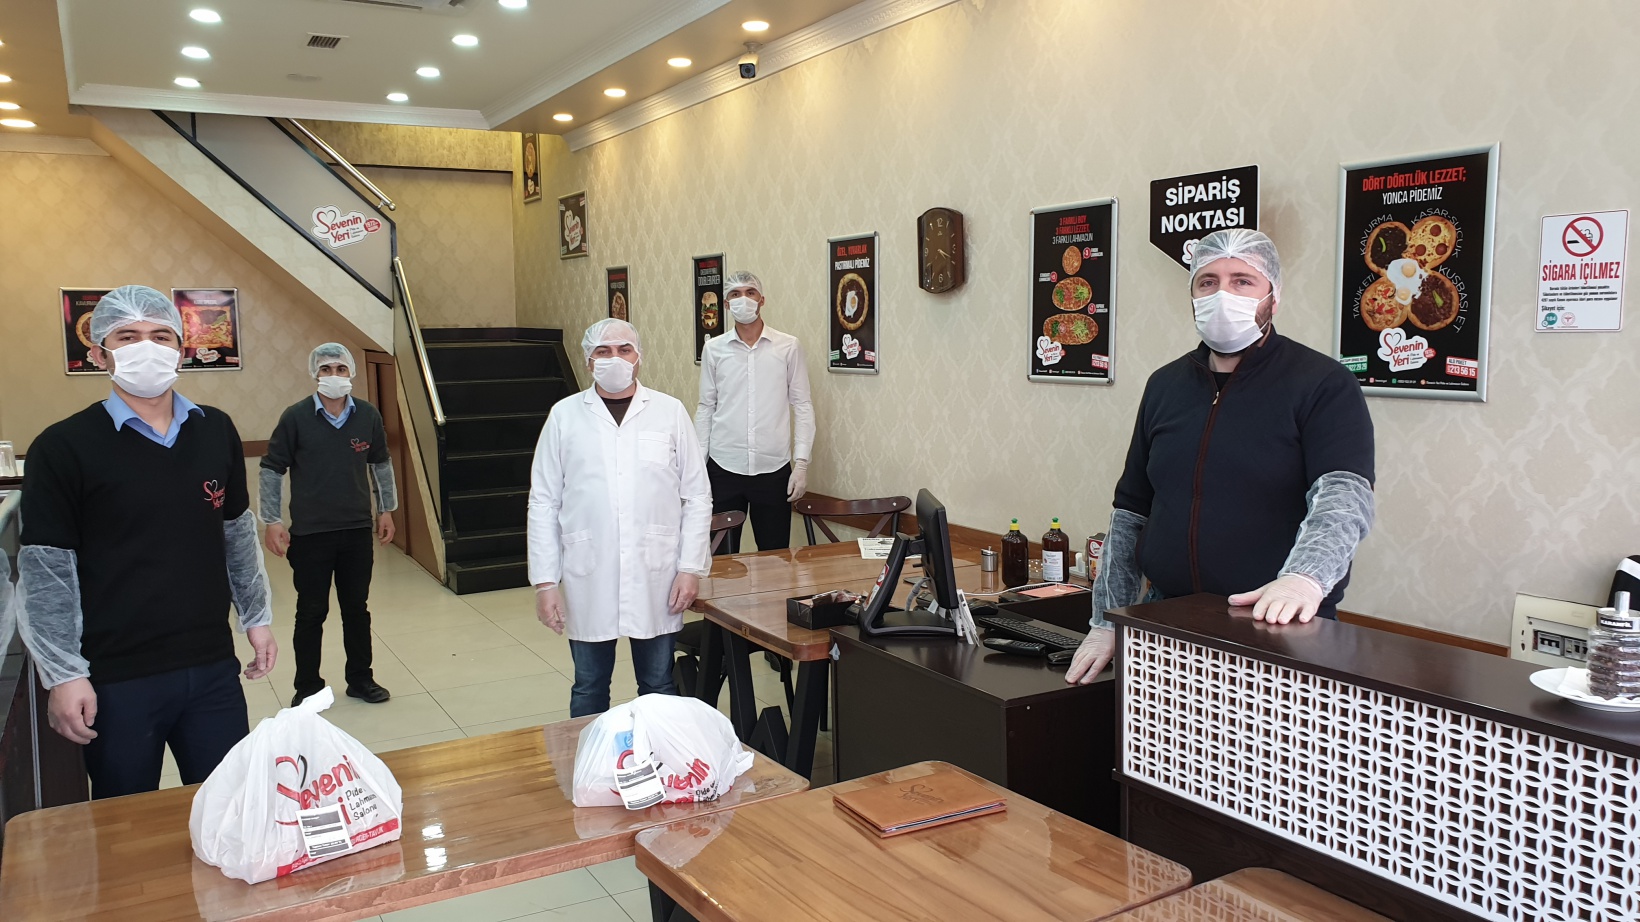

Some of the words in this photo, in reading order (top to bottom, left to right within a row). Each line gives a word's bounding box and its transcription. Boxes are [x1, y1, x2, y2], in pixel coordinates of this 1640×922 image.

[1165, 176, 1240, 206] SİPARİŞ
[1363, 176, 1385, 191] DÖRT
[1387, 170, 1427, 189] DÖRTLÜK
[1430, 167, 1466, 184] LEZZET;
[1382, 191, 1408, 205] YONCA
[1409, 184, 1443, 203] PİDEMİZ
[317, 209, 362, 234] Sevenin
[1161, 207, 1245, 234] NOKTASI
[331, 229, 350, 243] Yeri
[1360, 213, 1393, 256] KAVURMA
[1542, 260, 1576, 281] SİGARA
[1580, 258, 1620, 284] İÇİLMEZ
[1353, 286, 1365, 319] TAVUK
[1453, 315, 1466, 333] ET
[1383, 332, 1424, 357] Sevenin
[1393, 354, 1409, 367] Yeri
